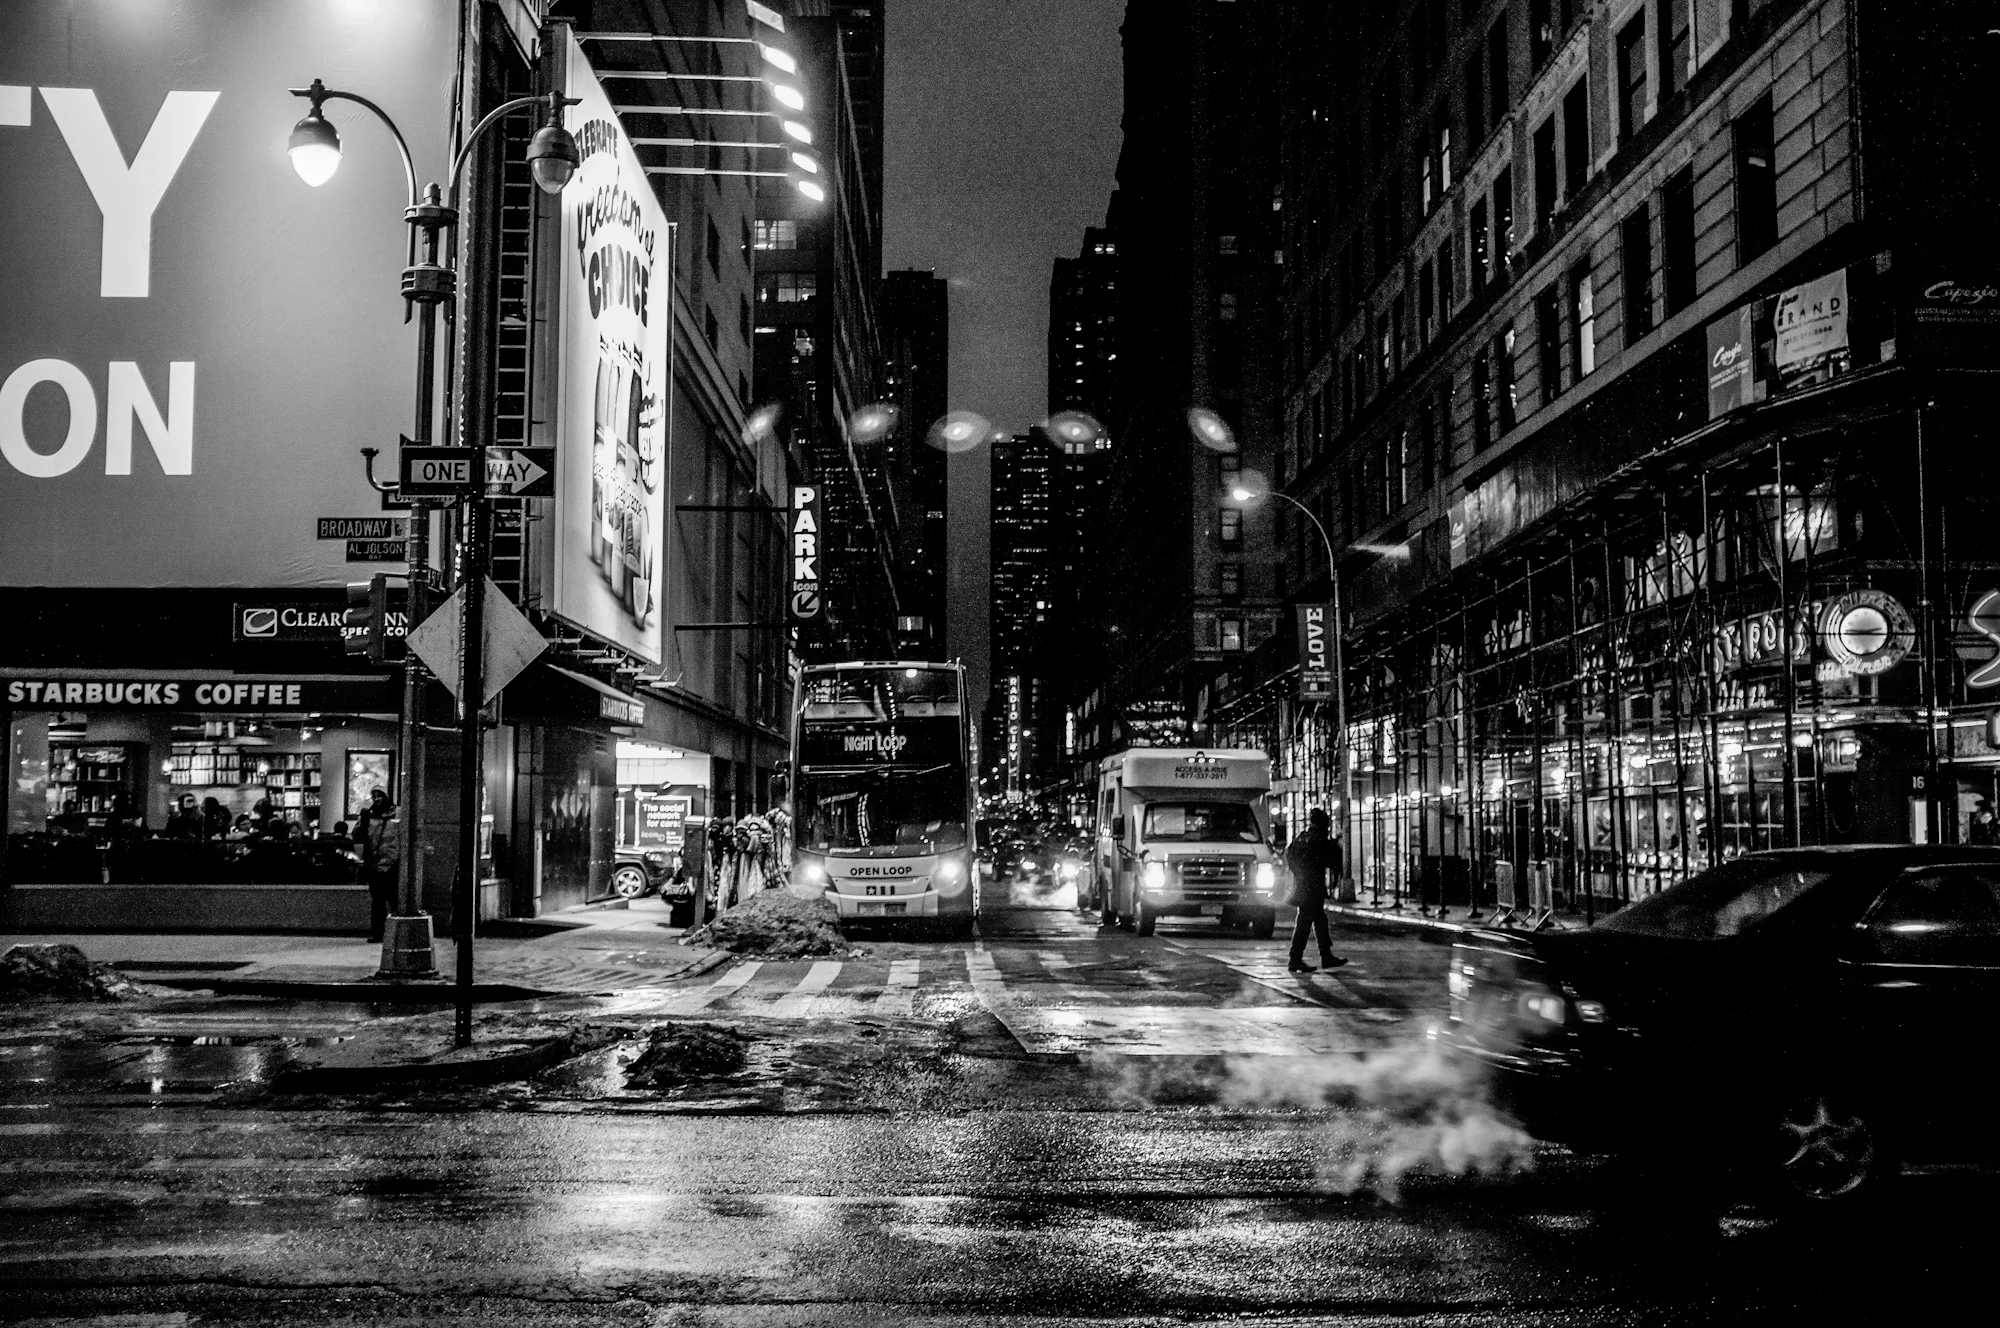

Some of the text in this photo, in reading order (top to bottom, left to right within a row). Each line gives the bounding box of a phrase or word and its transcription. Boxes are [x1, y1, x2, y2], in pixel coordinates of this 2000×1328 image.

[0, 86, 221, 298] Y
[588, 243, 649, 328] CHOICE
[0, 358, 195, 478] ON
[422, 462, 532, 483] ONE WAY
[319, 520, 388, 537] BROADWAY
[792, 485, 817, 582] PARK
[348, 541, 403, 555] AL JOLSON
[792, 580, 818, 592] icon
[1306, 607, 1325, 668] LOVE
[8, 681, 302, 706] STARBUCKS COFFEE
[1009, 676, 1019, 720] RADIO
[844, 735, 907, 751] NIGHT LOOP
[642, 802, 685, 814] The social
[646, 811, 681, 820] network
[646, 819, 659, 828] for
[849, 866, 912, 876] OPEN LOOP
